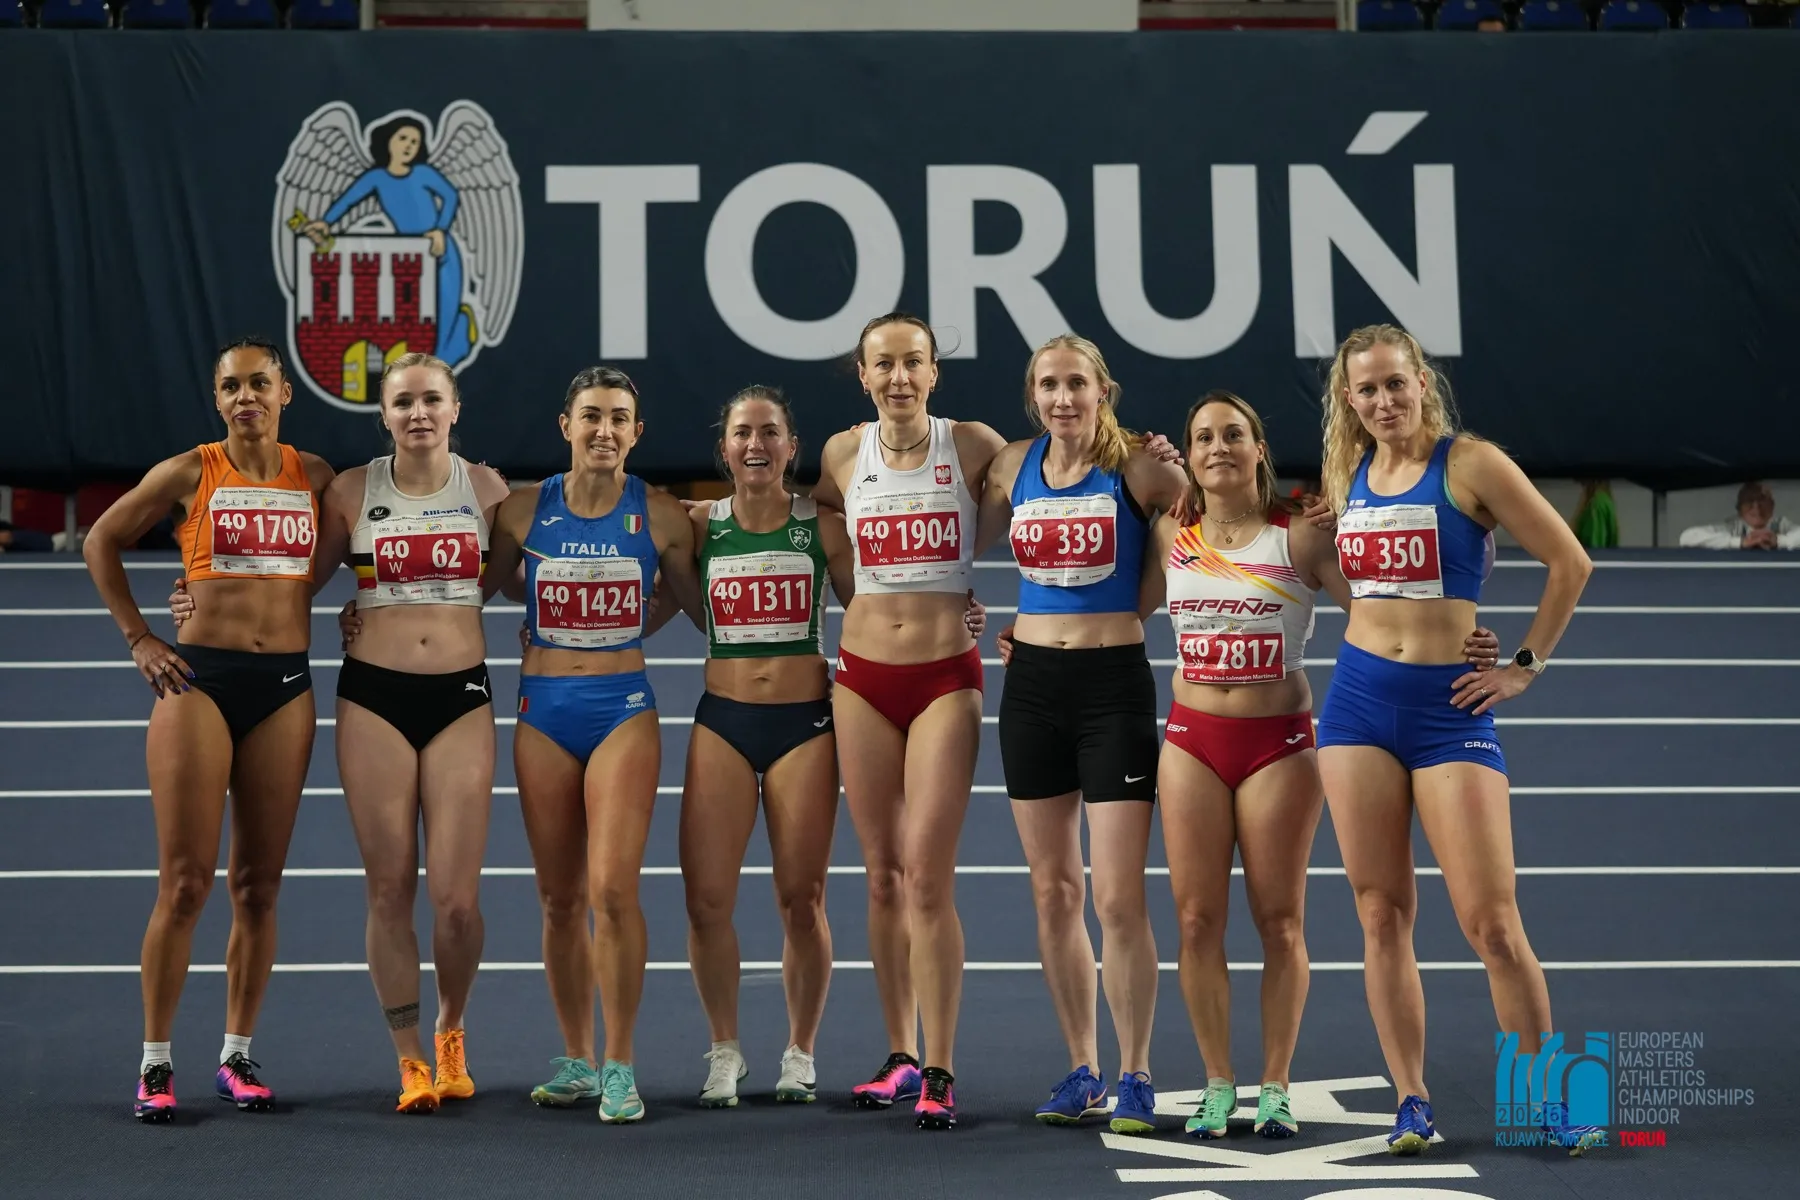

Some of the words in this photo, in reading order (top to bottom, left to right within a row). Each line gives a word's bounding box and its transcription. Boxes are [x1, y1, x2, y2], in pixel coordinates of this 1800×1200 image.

[545, 111, 1462, 360] TORUŃ
[218, 513, 247, 530] 40
[253, 514, 312, 546] 1708
[860, 520, 889, 540] 40
[896, 518, 958, 550] 1904
[226, 532, 240, 545] W
[1015, 524, 1043, 543] 40
[1057, 522, 1103, 554] 339
[380, 540, 409, 559] 40
[432, 538, 462, 569] 62
[561, 542, 620, 556] ITALIA
[869, 542, 882, 554] W
[1023, 546, 1036, 557] W
[1342, 536, 1365, 556] 40
[1378, 536, 1425, 570] 350
[389, 562, 402, 574] W
[1348, 560, 1360, 571] W
[542, 586, 569, 604] 40
[576, 586, 638, 617] 1424
[714, 581, 742, 600] 40
[748, 580, 805, 612] 1311
[550, 606, 563, 617] W
[722, 602, 735, 614] W
[1184, 638, 1209, 657] 40
[1216, 639, 1279, 670] 2817
[1166, 723, 1188, 733] ESP
[1465, 741, 1496, 751] CRAFT
